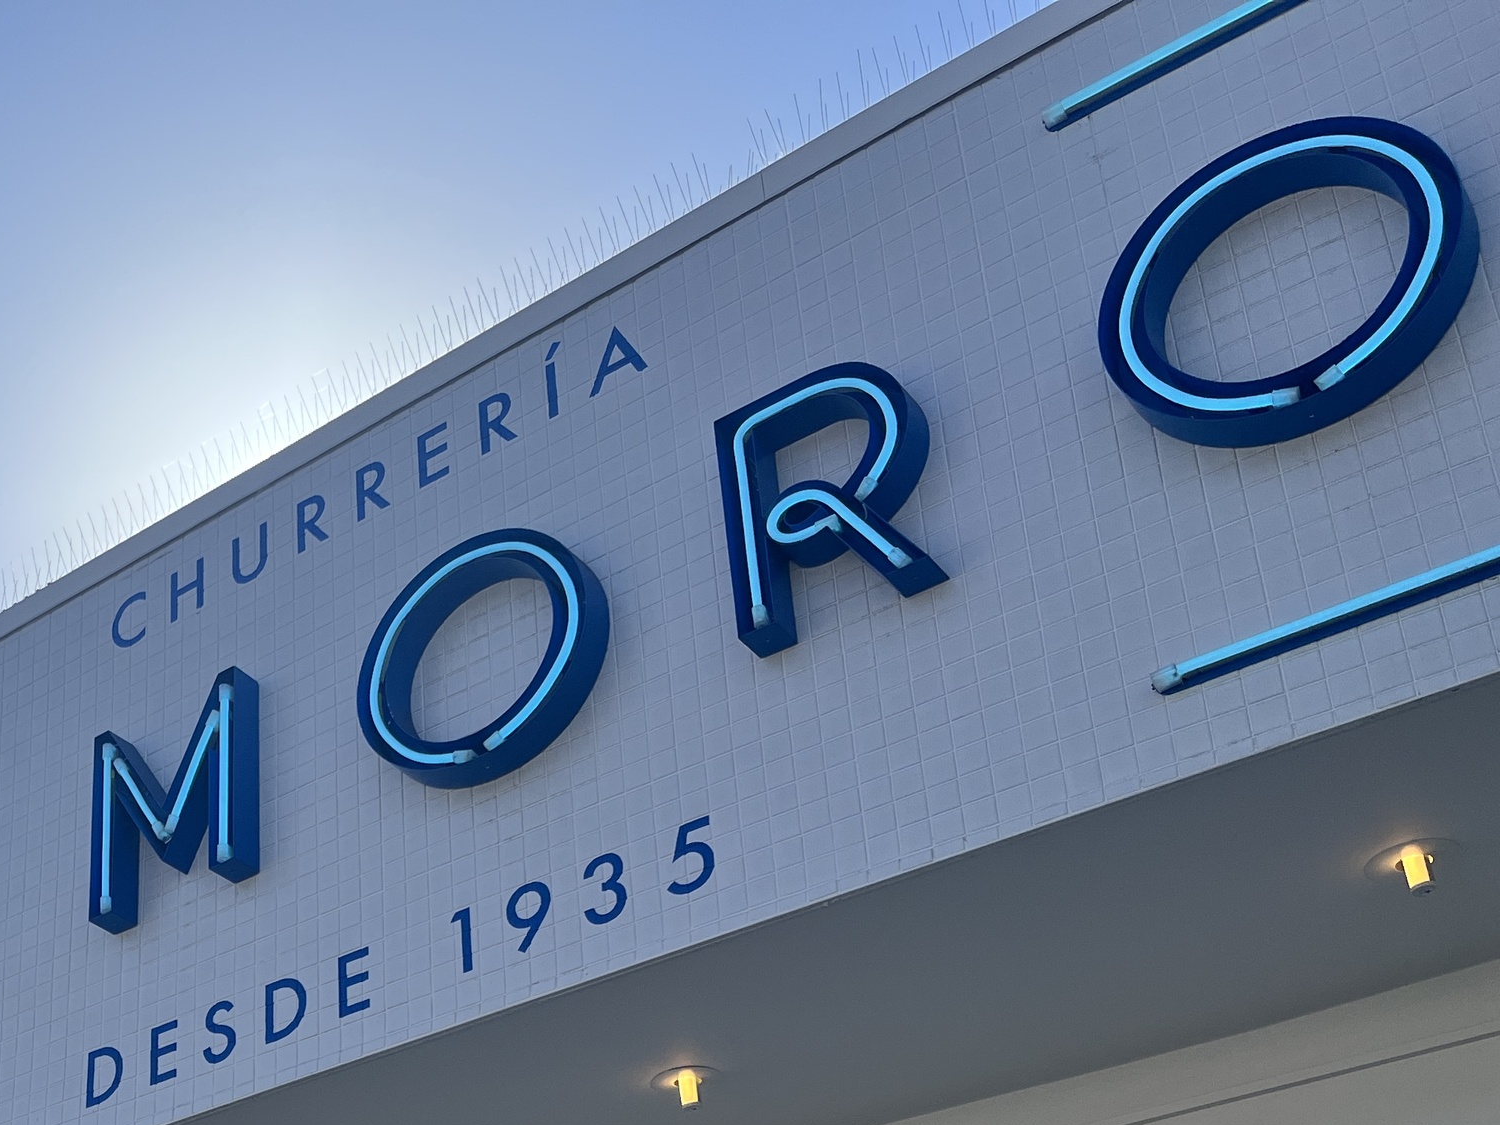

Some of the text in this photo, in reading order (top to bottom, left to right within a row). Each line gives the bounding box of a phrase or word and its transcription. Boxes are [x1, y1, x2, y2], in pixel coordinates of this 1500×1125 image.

[88, 115, 1480, 935] MORO
[111, 326, 648, 648] CHURRERÍA
[85, 815, 716, 1108] DESDE 1935
